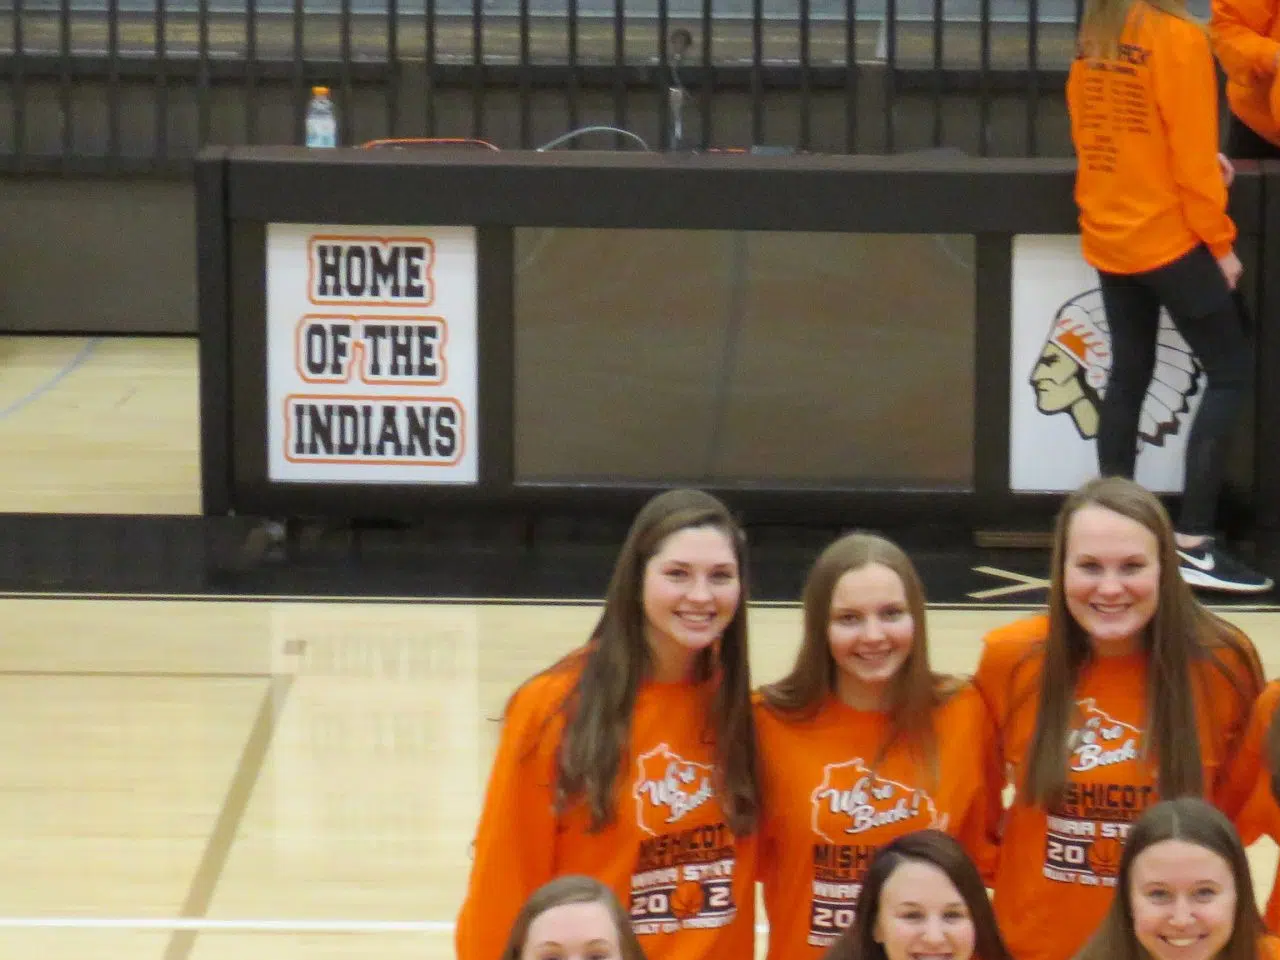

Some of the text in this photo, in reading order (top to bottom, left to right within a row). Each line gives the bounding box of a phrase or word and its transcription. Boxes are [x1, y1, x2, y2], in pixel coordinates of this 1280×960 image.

[317, 245, 425, 297] HOME
[306, 323, 437, 376] OF THE
[294, 403, 457, 457] INDIANS
[1047, 840, 1085, 864] 20
[813, 907, 857, 929] 20
